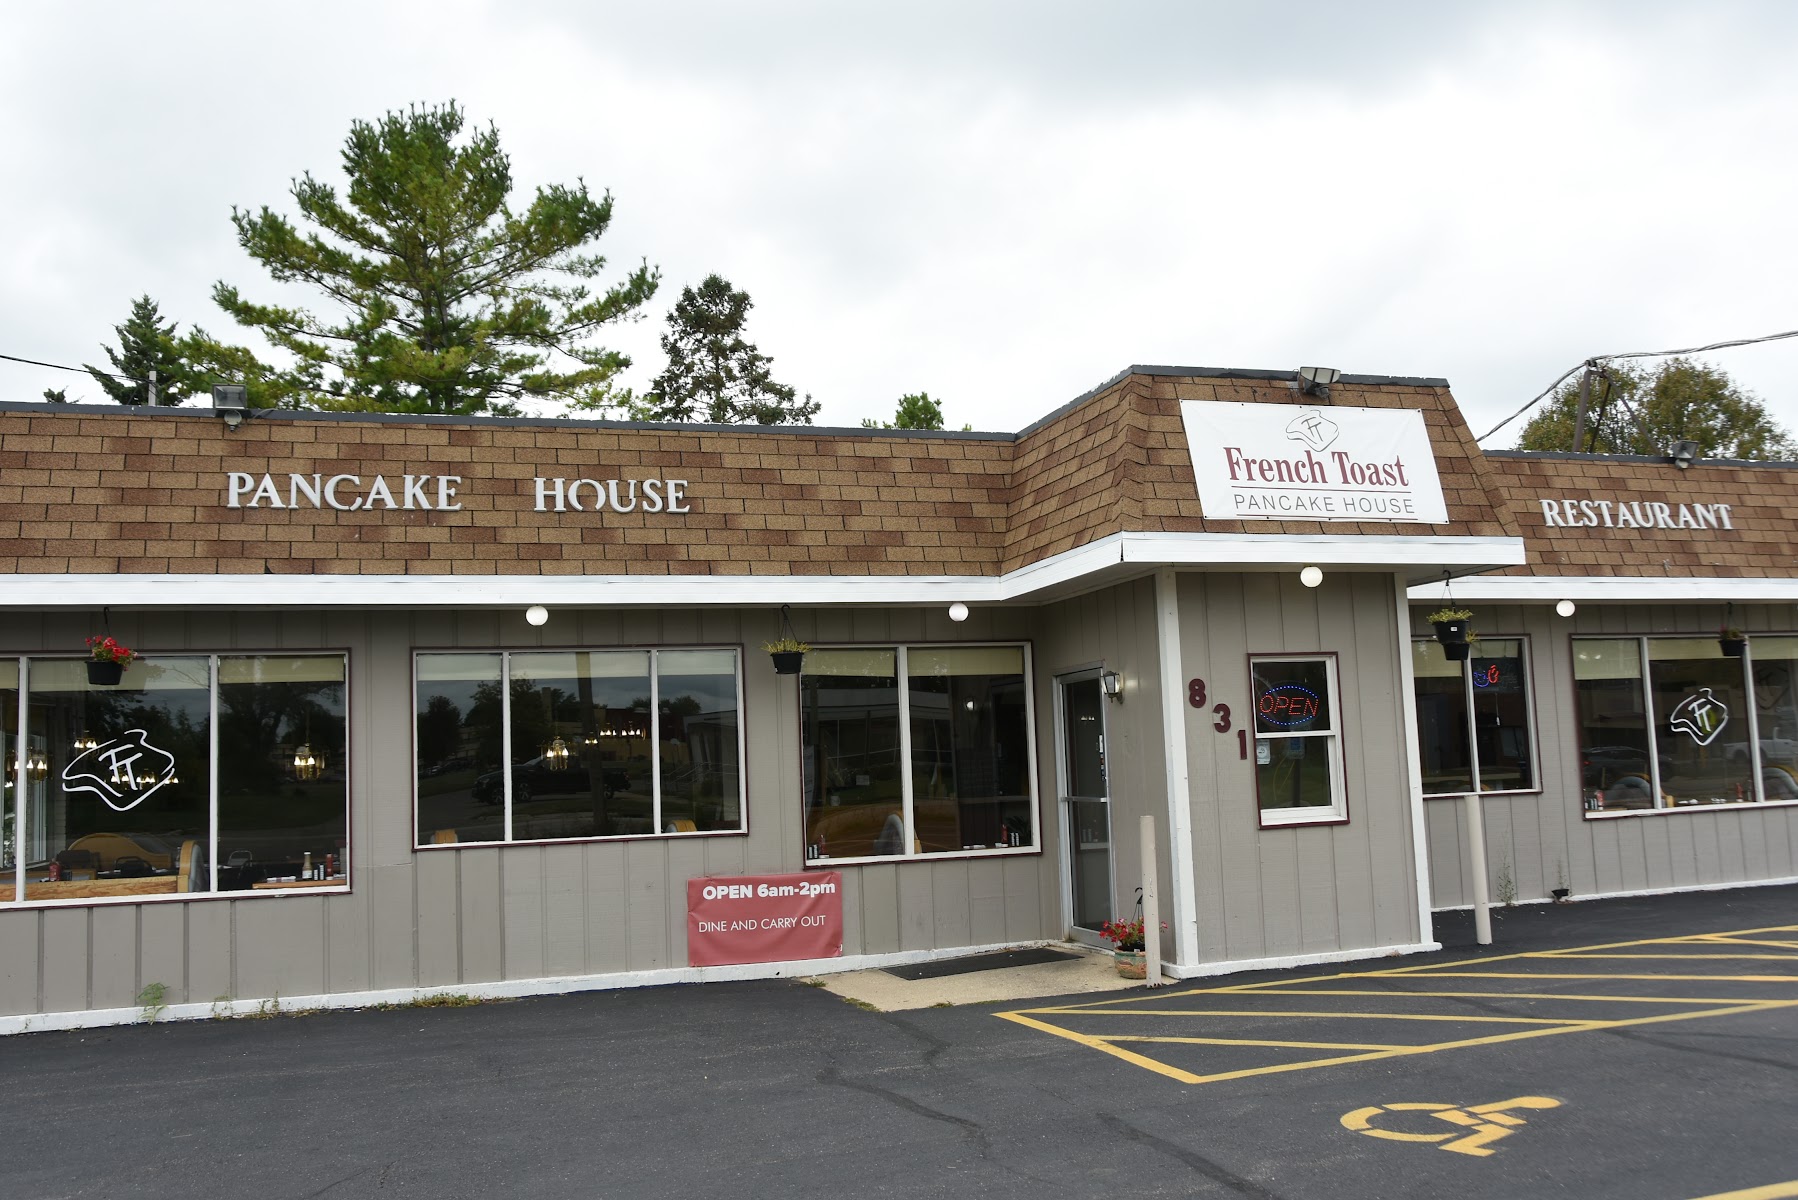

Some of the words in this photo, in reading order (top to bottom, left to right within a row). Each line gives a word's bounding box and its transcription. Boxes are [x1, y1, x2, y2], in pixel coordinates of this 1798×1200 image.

[1223, 446, 1329, 485] French
[1331, 451, 1409, 487] Toast
[226, 472, 461, 512] PANCAKE
[533, 477, 690, 514] HOUSE
[1233, 494, 1335, 512] PANCAKE
[1343, 497, 1415, 514] HOUSE
[1539, 499, 1734, 530] RESTAURANT
[1258, 694, 1319, 717] OPEN
[702, 884, 753, 900] OPEN
[757, 881, 836, 898] 6am-2pm
[698, 920, 727, 933] DINE
[730, 919, 757, 931] AND
[760, 917, 798, 930] CARRY
[800, 915, 826, 927] OUT
